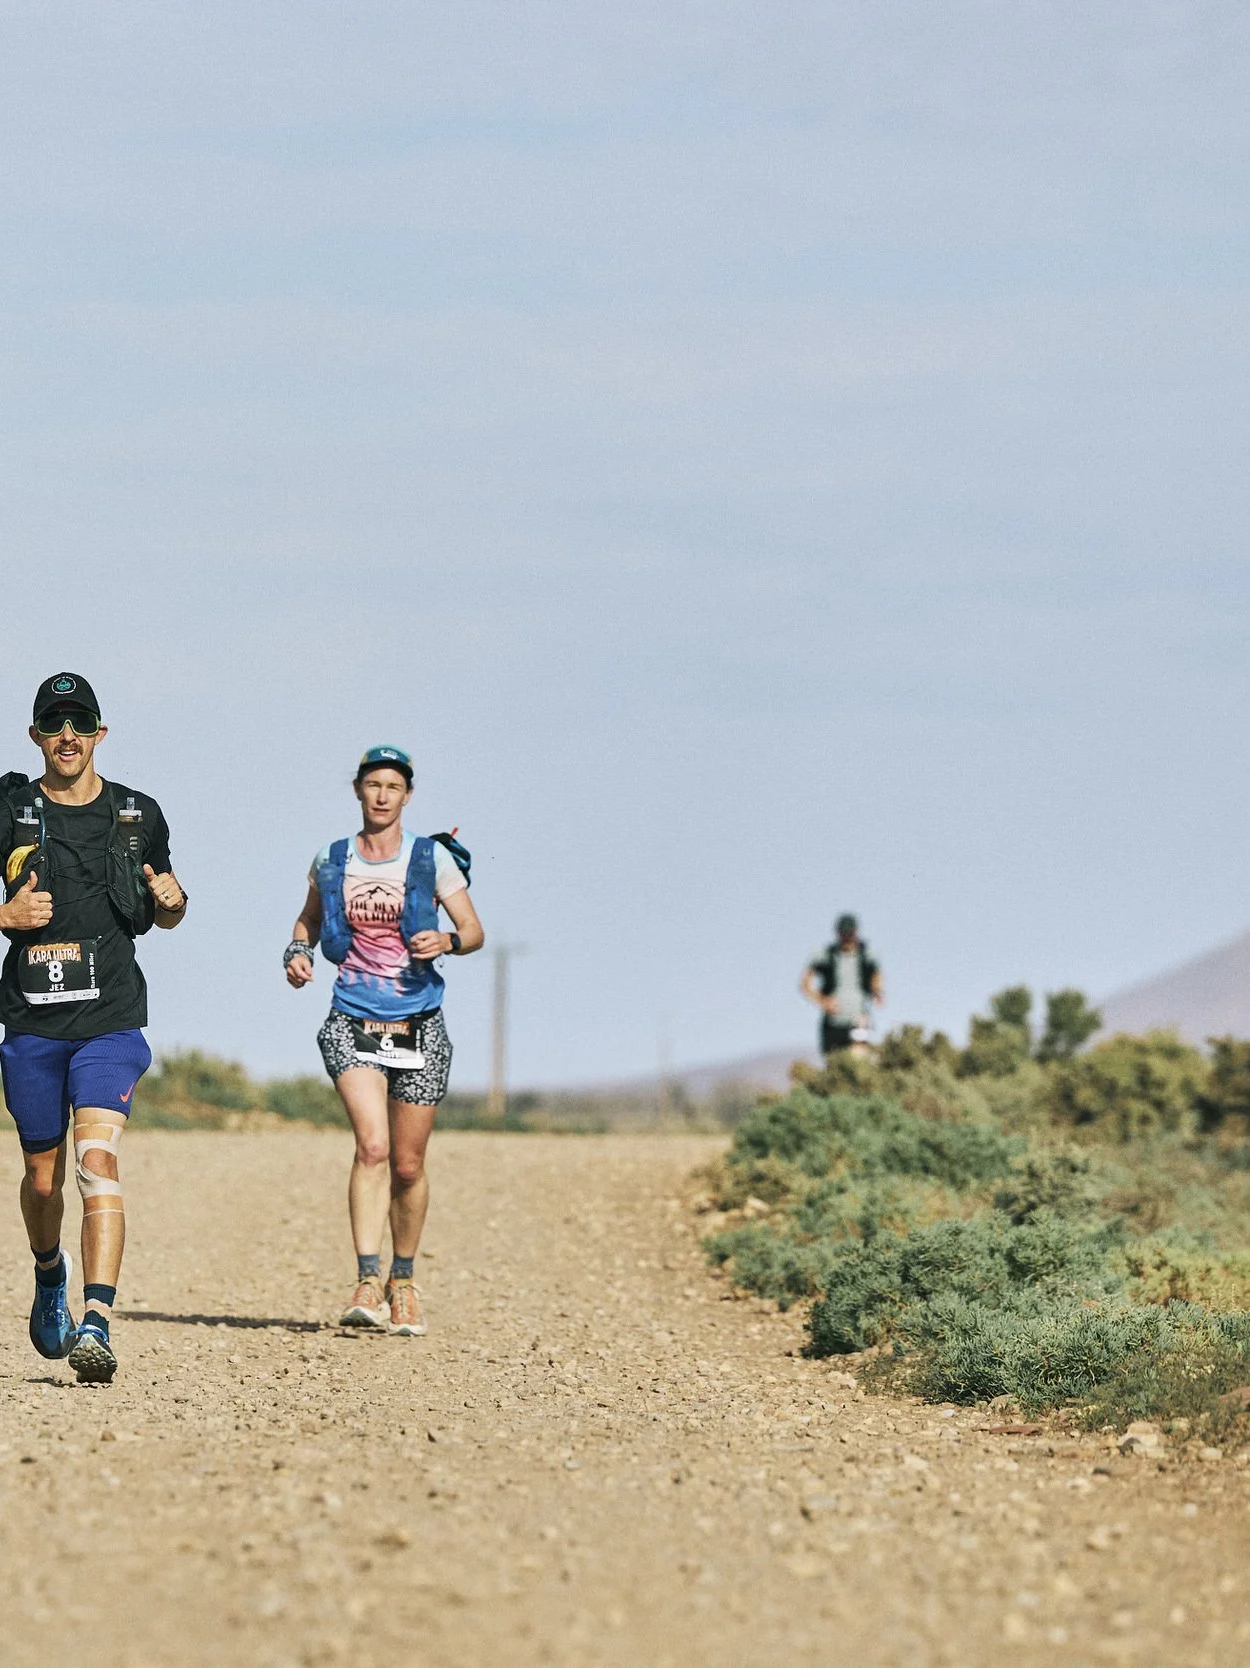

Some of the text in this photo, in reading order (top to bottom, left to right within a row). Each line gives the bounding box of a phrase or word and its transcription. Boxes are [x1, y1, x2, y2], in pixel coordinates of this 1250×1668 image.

[349, 900, 402, 914] THE NEXT
[28, 947, 80, 965] IKARA ULTRA
[48, 960, 64, 983] 8
[49, 983, 65, 992] JEZ
[380, 1033, 395, 1051] 6
